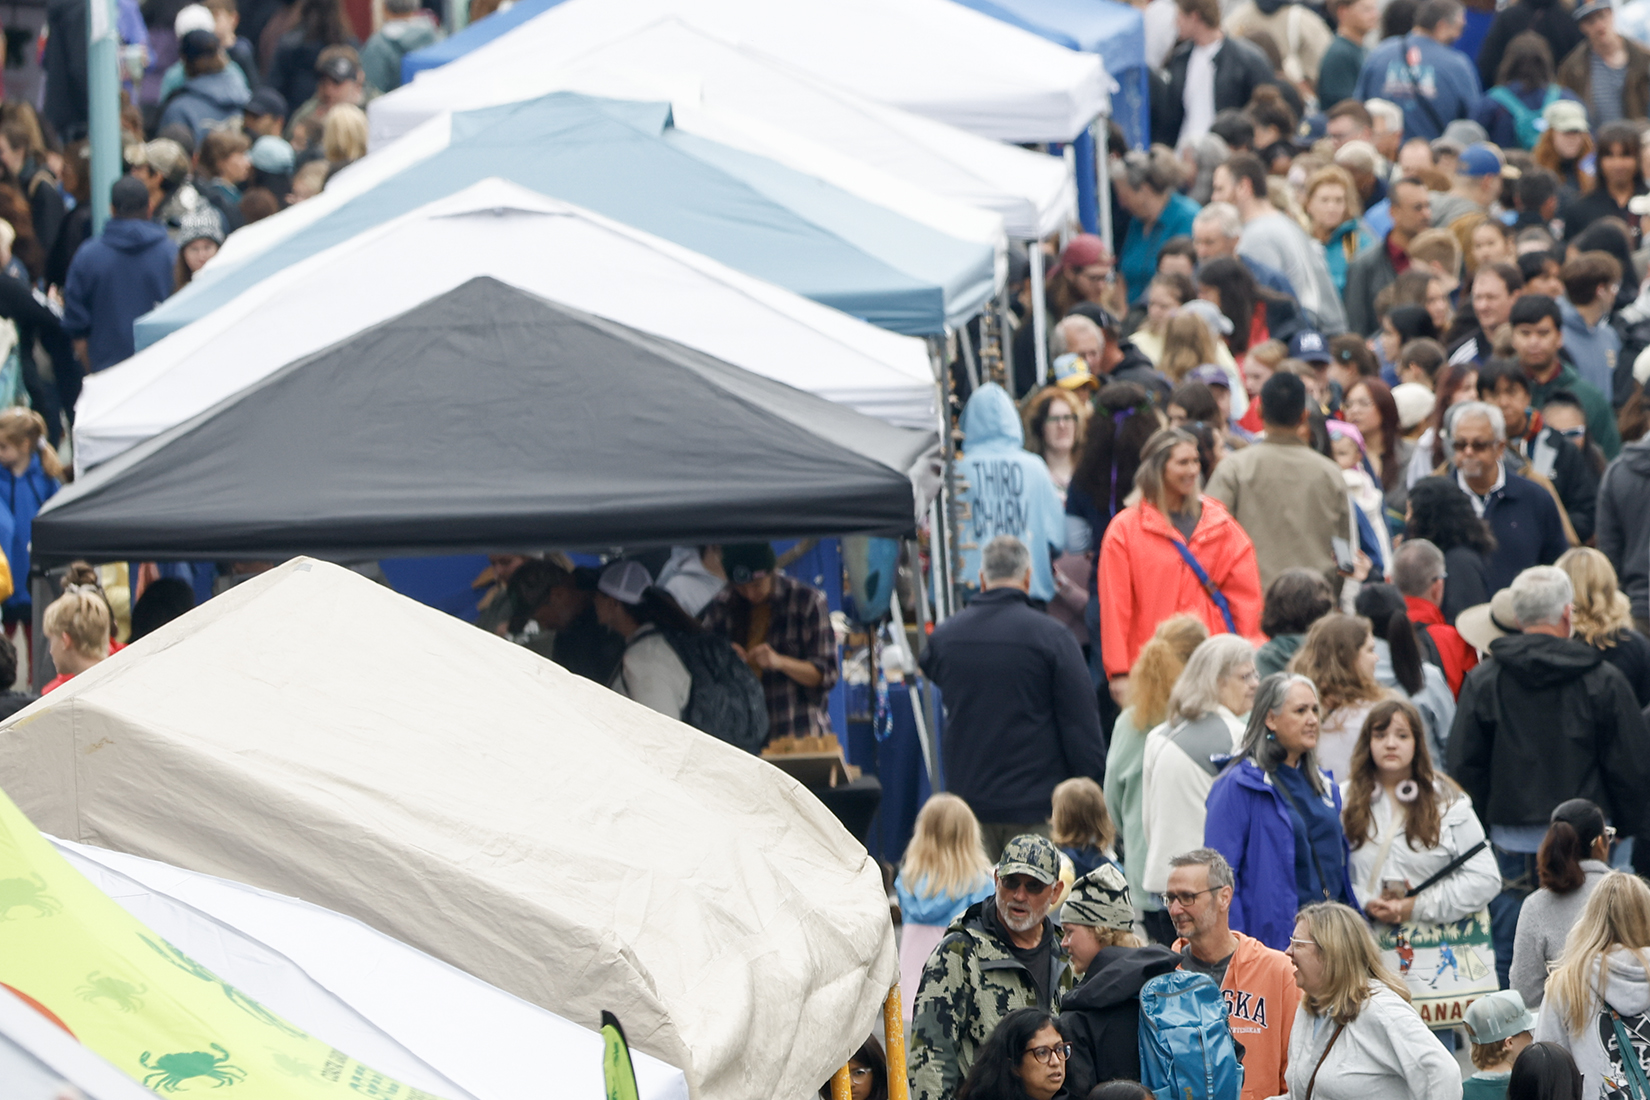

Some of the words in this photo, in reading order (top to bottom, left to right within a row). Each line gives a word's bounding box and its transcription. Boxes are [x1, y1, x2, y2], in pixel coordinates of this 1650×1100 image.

[972, 460, 1024, 497] THIRD
[971, 498, 1028, 538] CHARM
[1220, 989, 1269, 1029] SKA
[1420, 999, 1476, 1021] ANA
